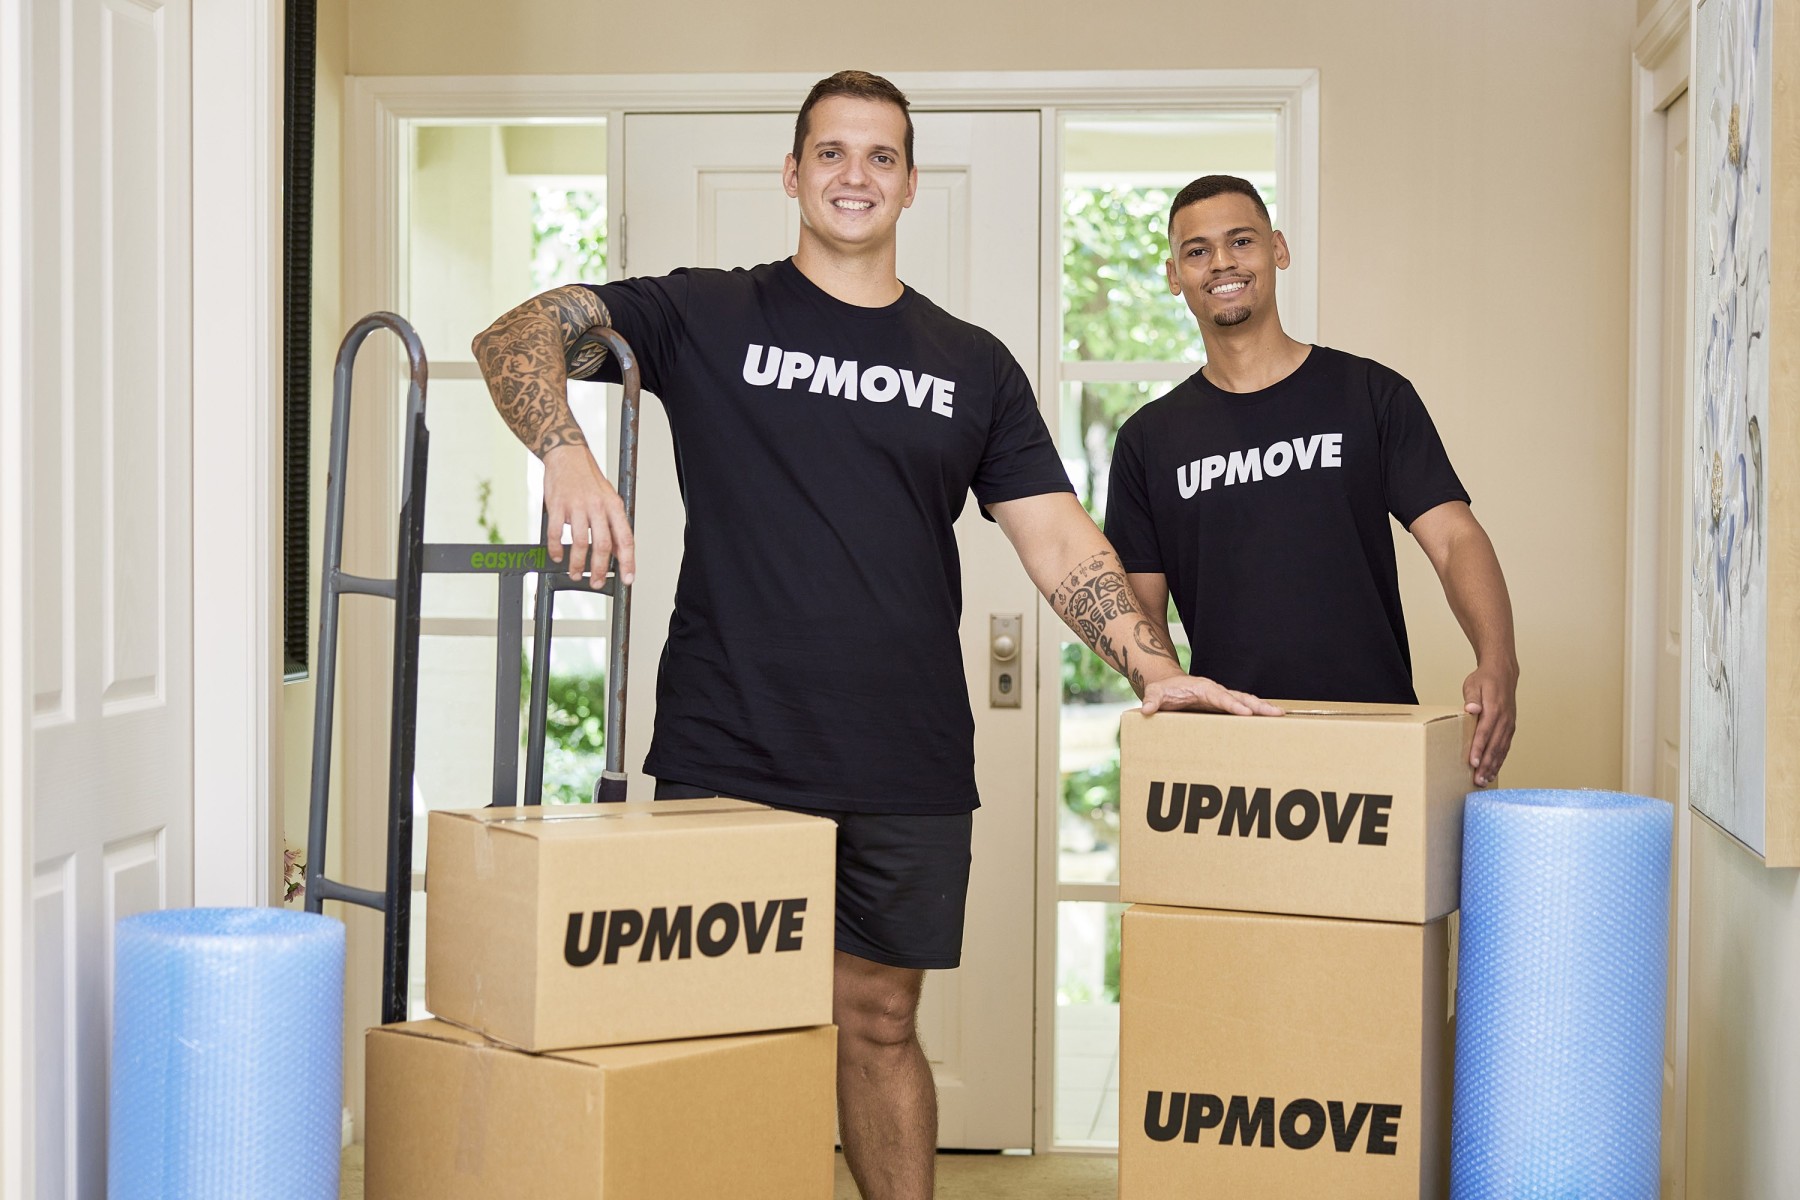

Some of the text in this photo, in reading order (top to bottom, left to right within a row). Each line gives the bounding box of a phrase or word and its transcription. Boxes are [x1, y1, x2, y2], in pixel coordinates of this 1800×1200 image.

[743, 343, 955, 418] UPMOVE
[1177, 433, 1343, 499] UPMOVE
[471, 547, 546, 569] easyroll
[1146, 781, 1393, 846] UPMOVE
[564, 898, 807, 967] UPMOVE
[1144, 1091, 1402, 1155] UPMOVE
